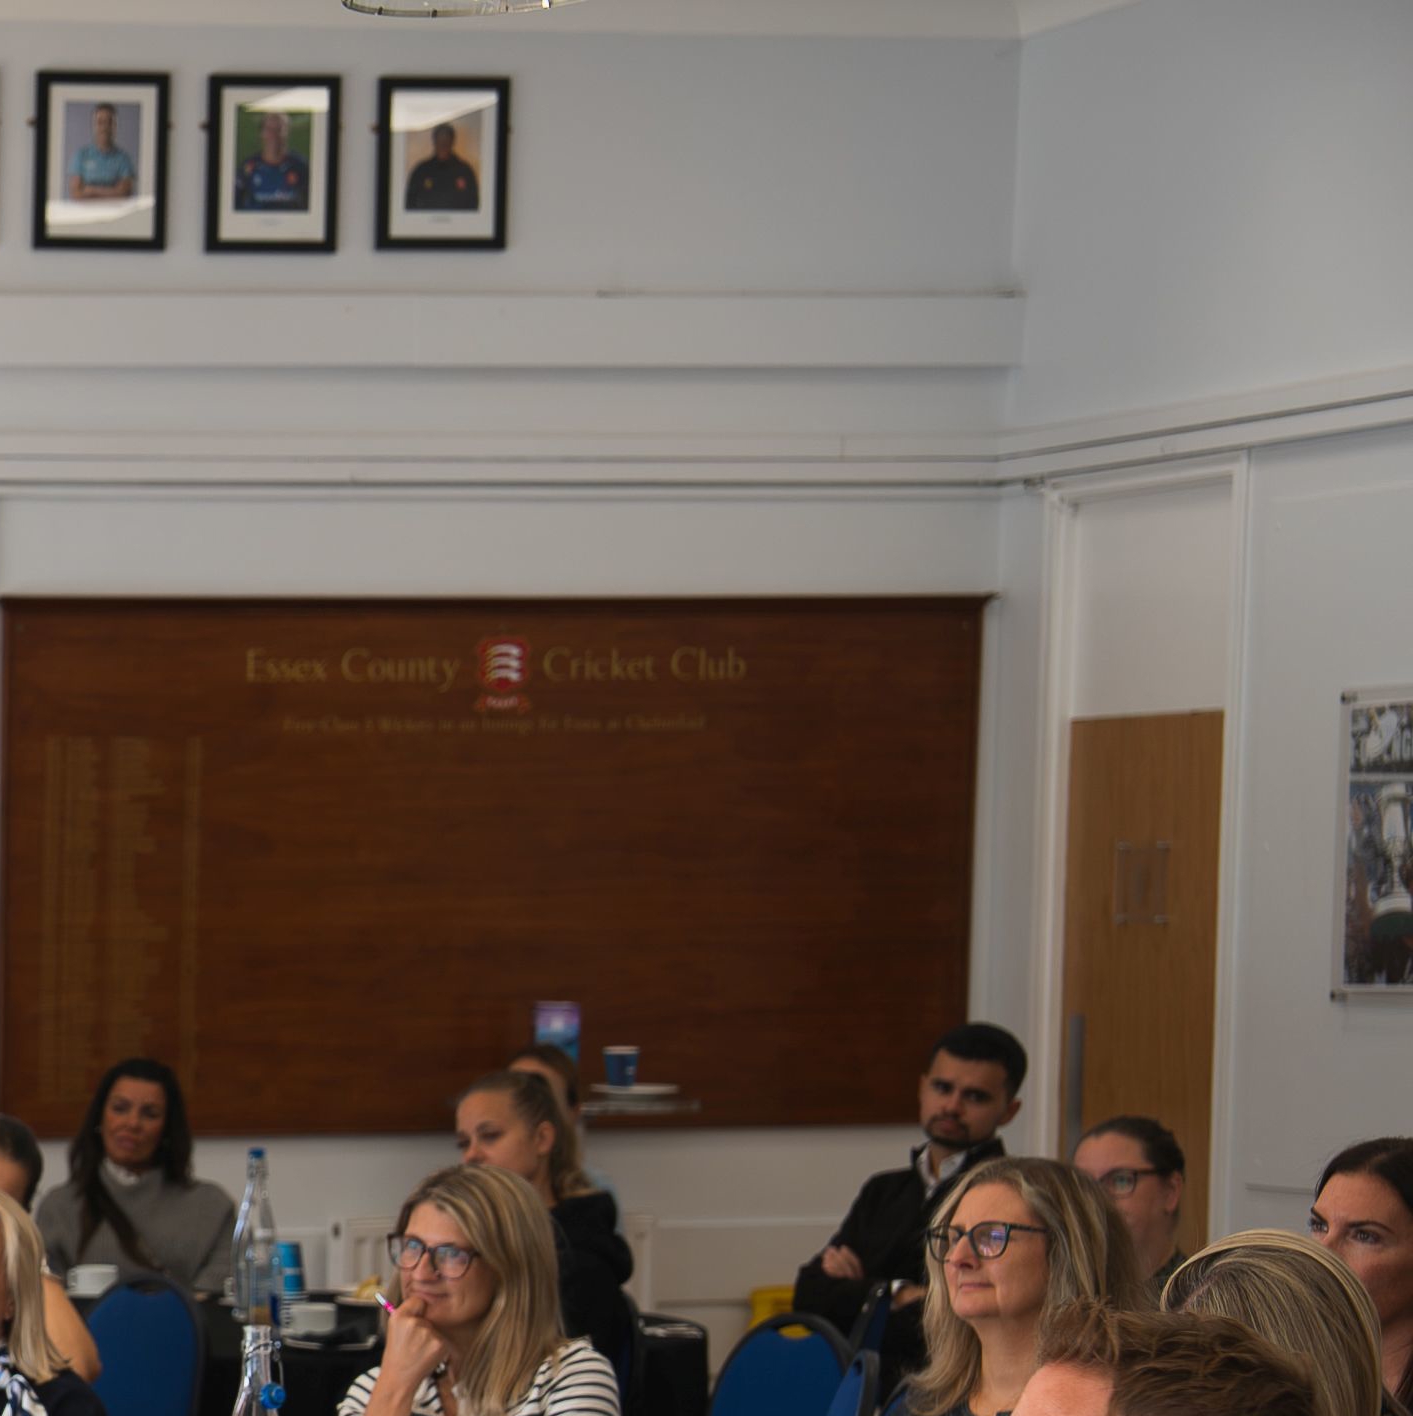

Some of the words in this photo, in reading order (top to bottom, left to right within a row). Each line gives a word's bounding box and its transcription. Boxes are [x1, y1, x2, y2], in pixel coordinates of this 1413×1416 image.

[246, 648, 327, 683] Essex
[340, 647, 461, 693] County
[543, 646, 657, 682] Cricket
[671, 645, 747, 682] Club
